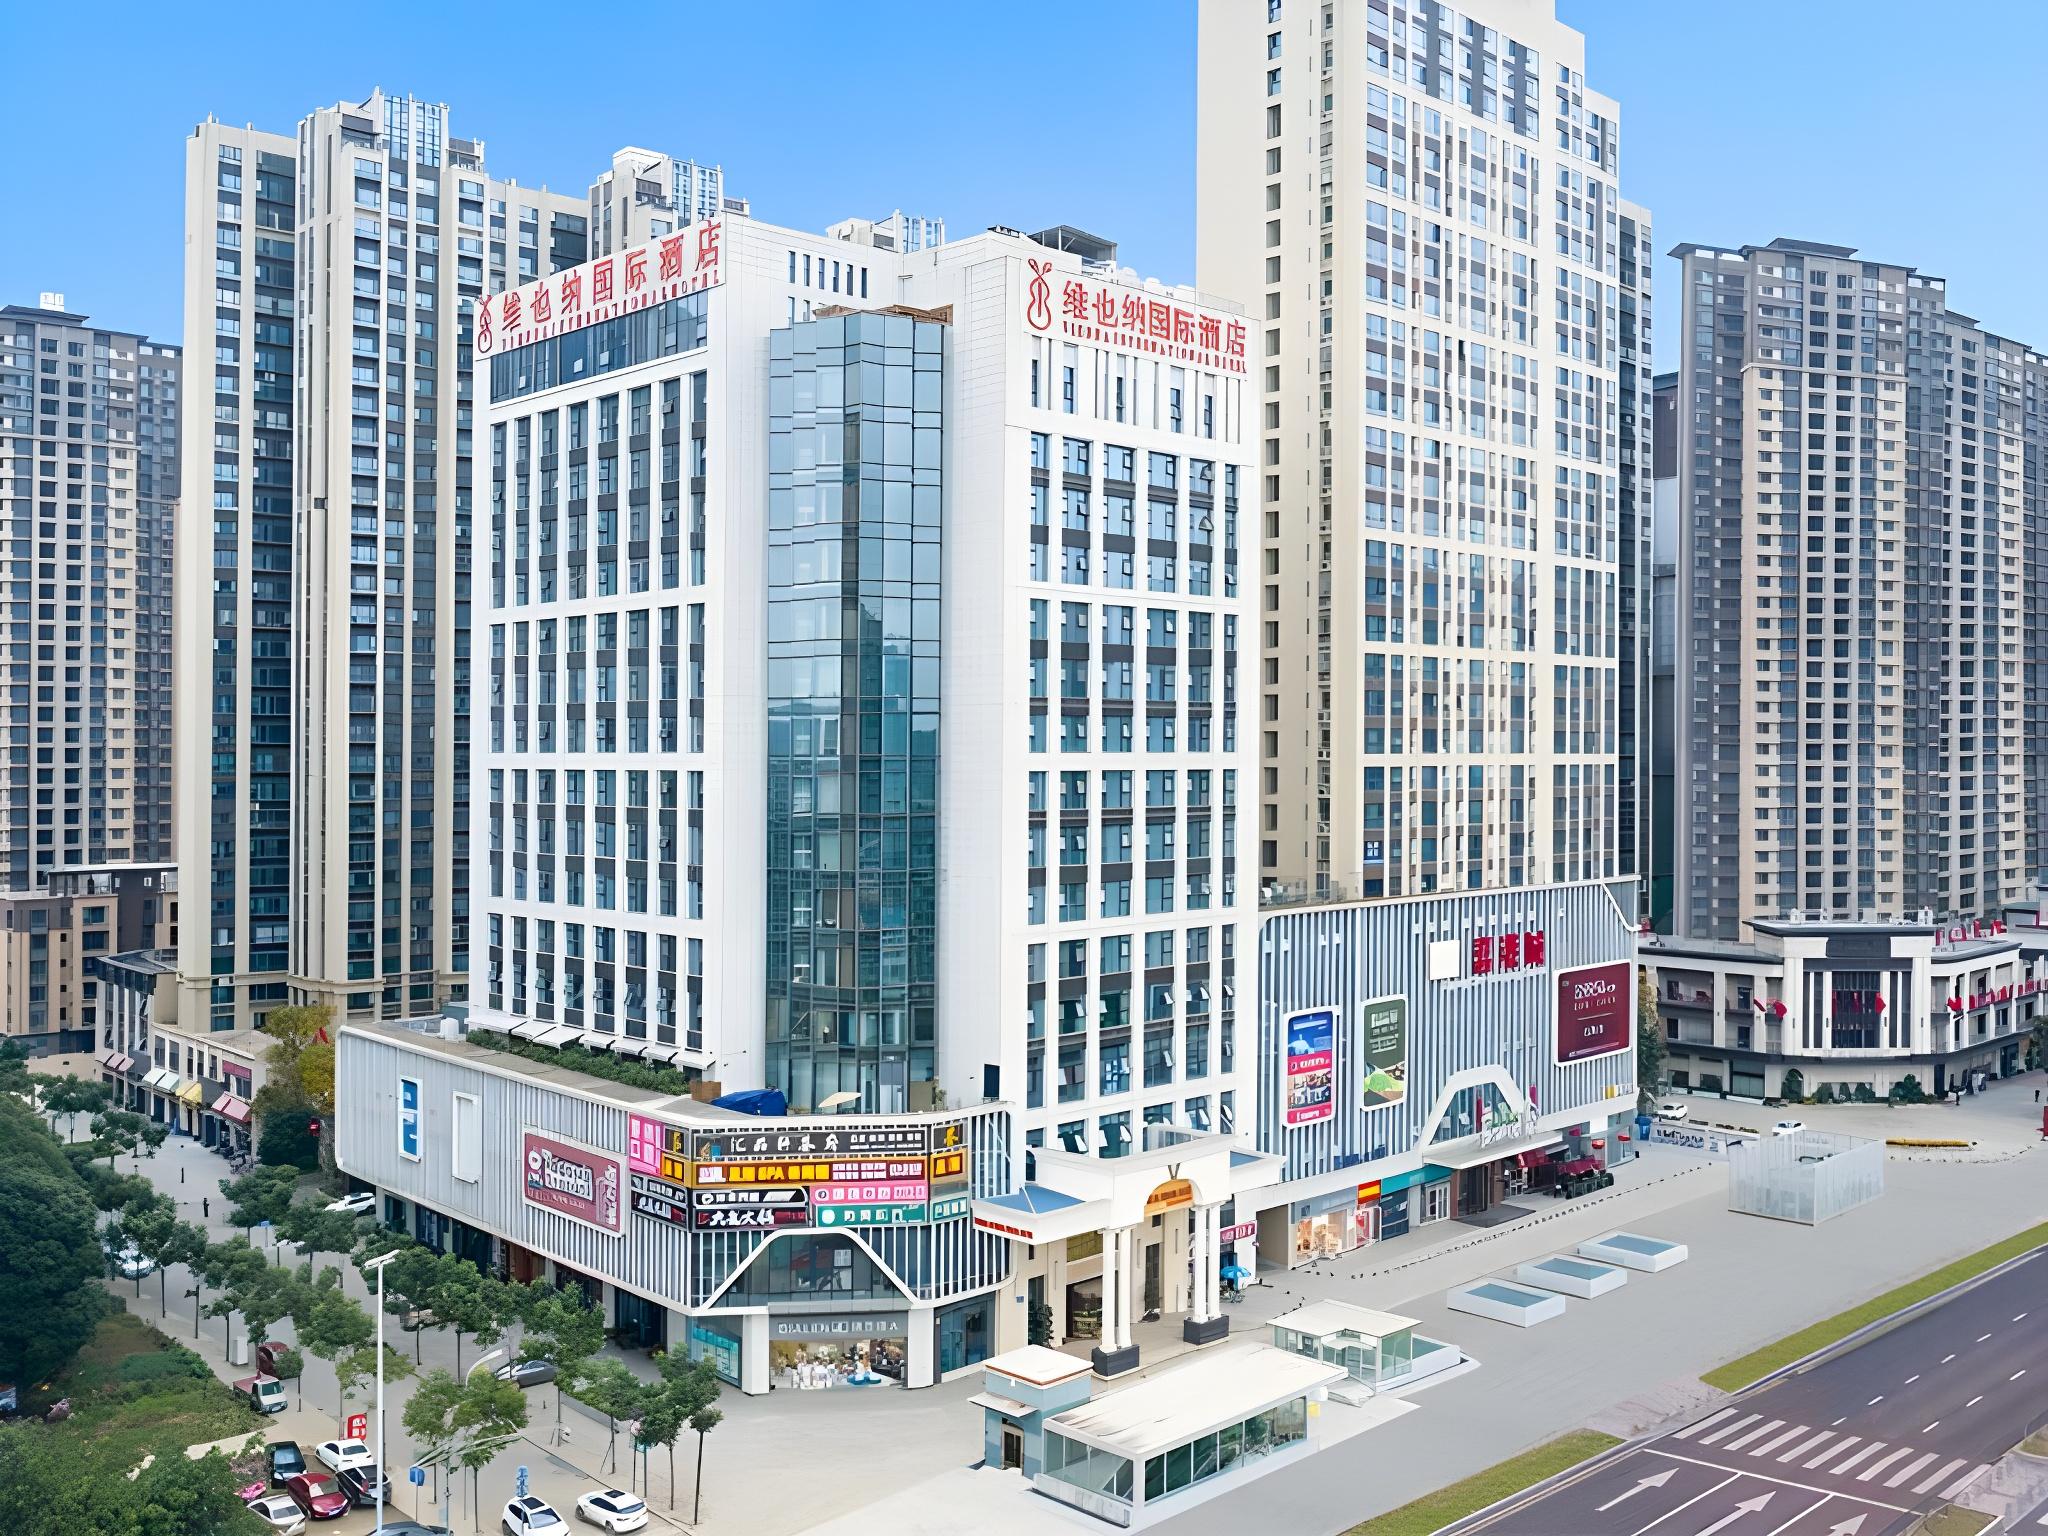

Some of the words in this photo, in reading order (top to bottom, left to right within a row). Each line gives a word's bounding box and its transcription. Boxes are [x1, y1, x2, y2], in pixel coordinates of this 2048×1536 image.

[552, 286, 667, 335] ITATIOAL
[1063, 280, 1246, 357] 维也纳国际酒店
